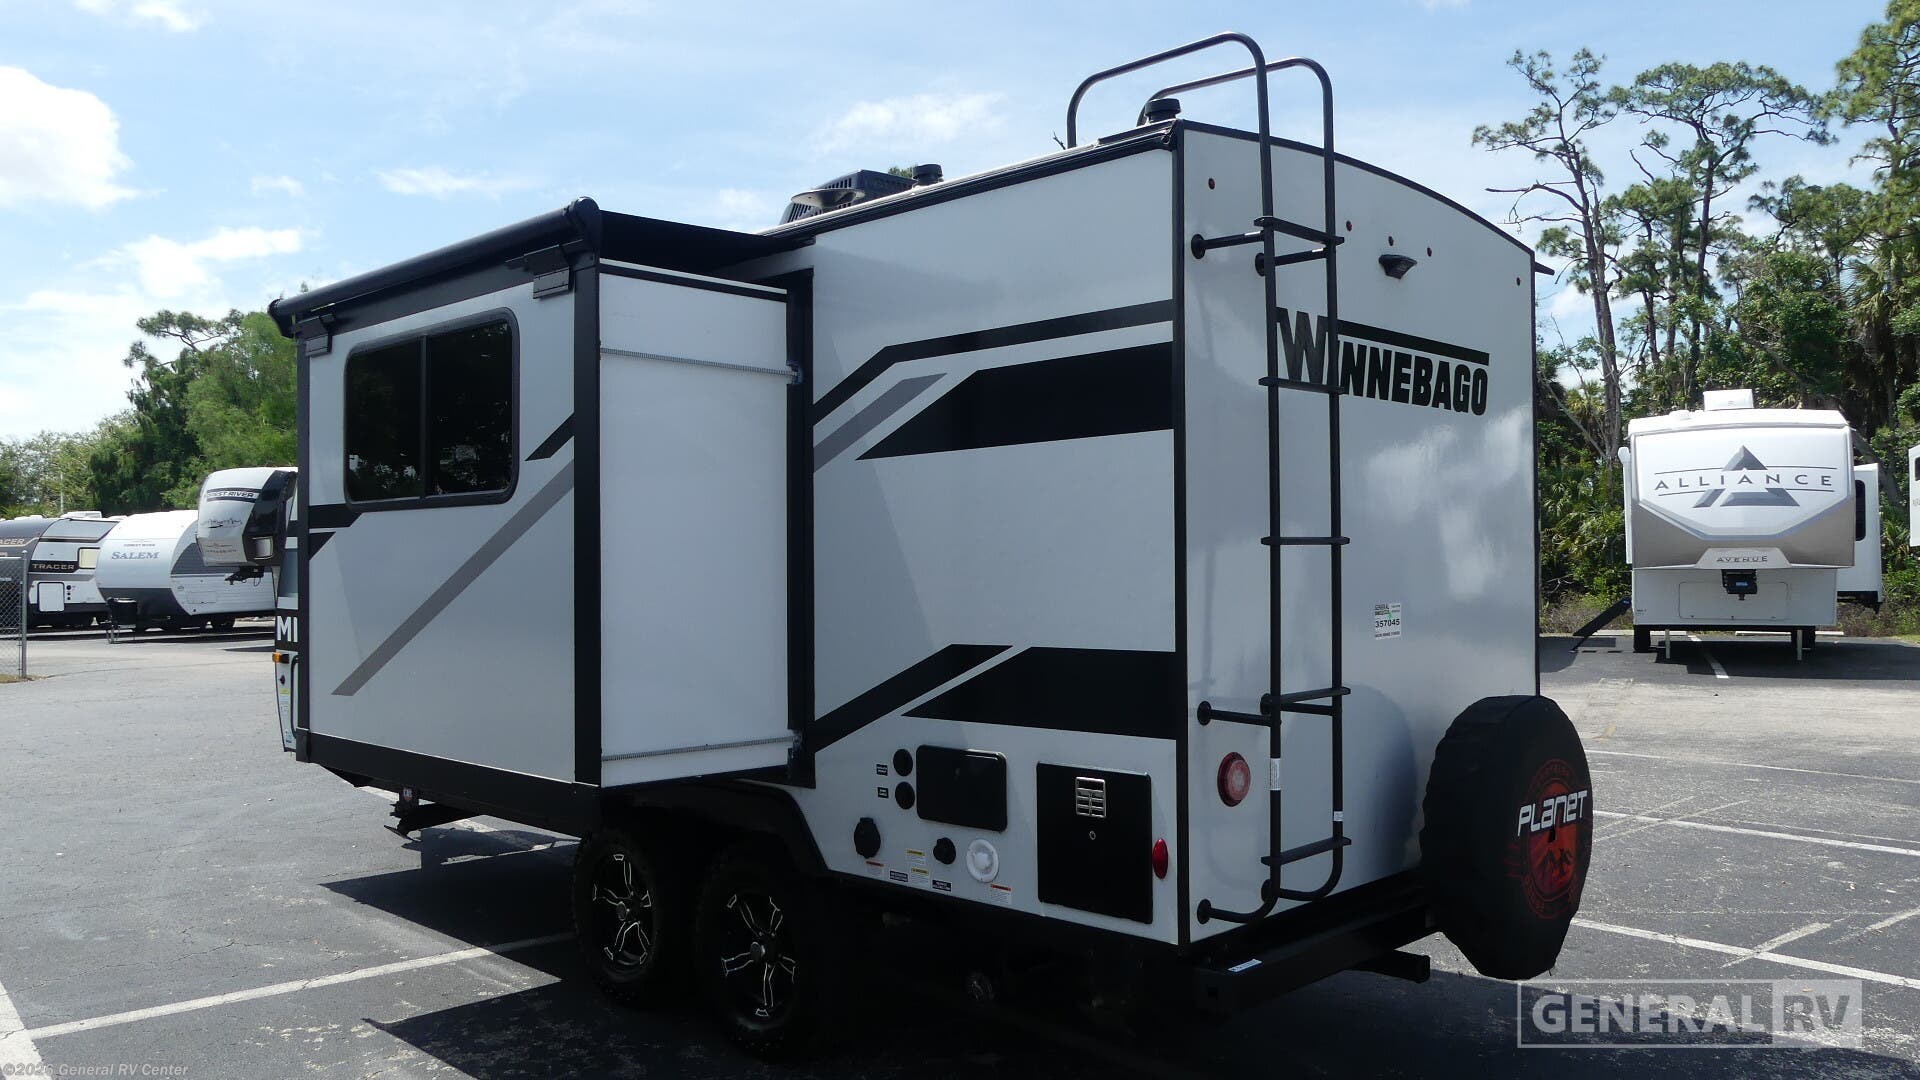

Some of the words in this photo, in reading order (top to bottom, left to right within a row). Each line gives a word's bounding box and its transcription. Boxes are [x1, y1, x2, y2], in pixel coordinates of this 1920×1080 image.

[1275, 306, 1488, 416] WNNEBAGO
[1654, 474, 1832, 490] ALLIANCE
[112, 551, 160, 560] SALEM
[1375, 619, 1400, 628] 357045
